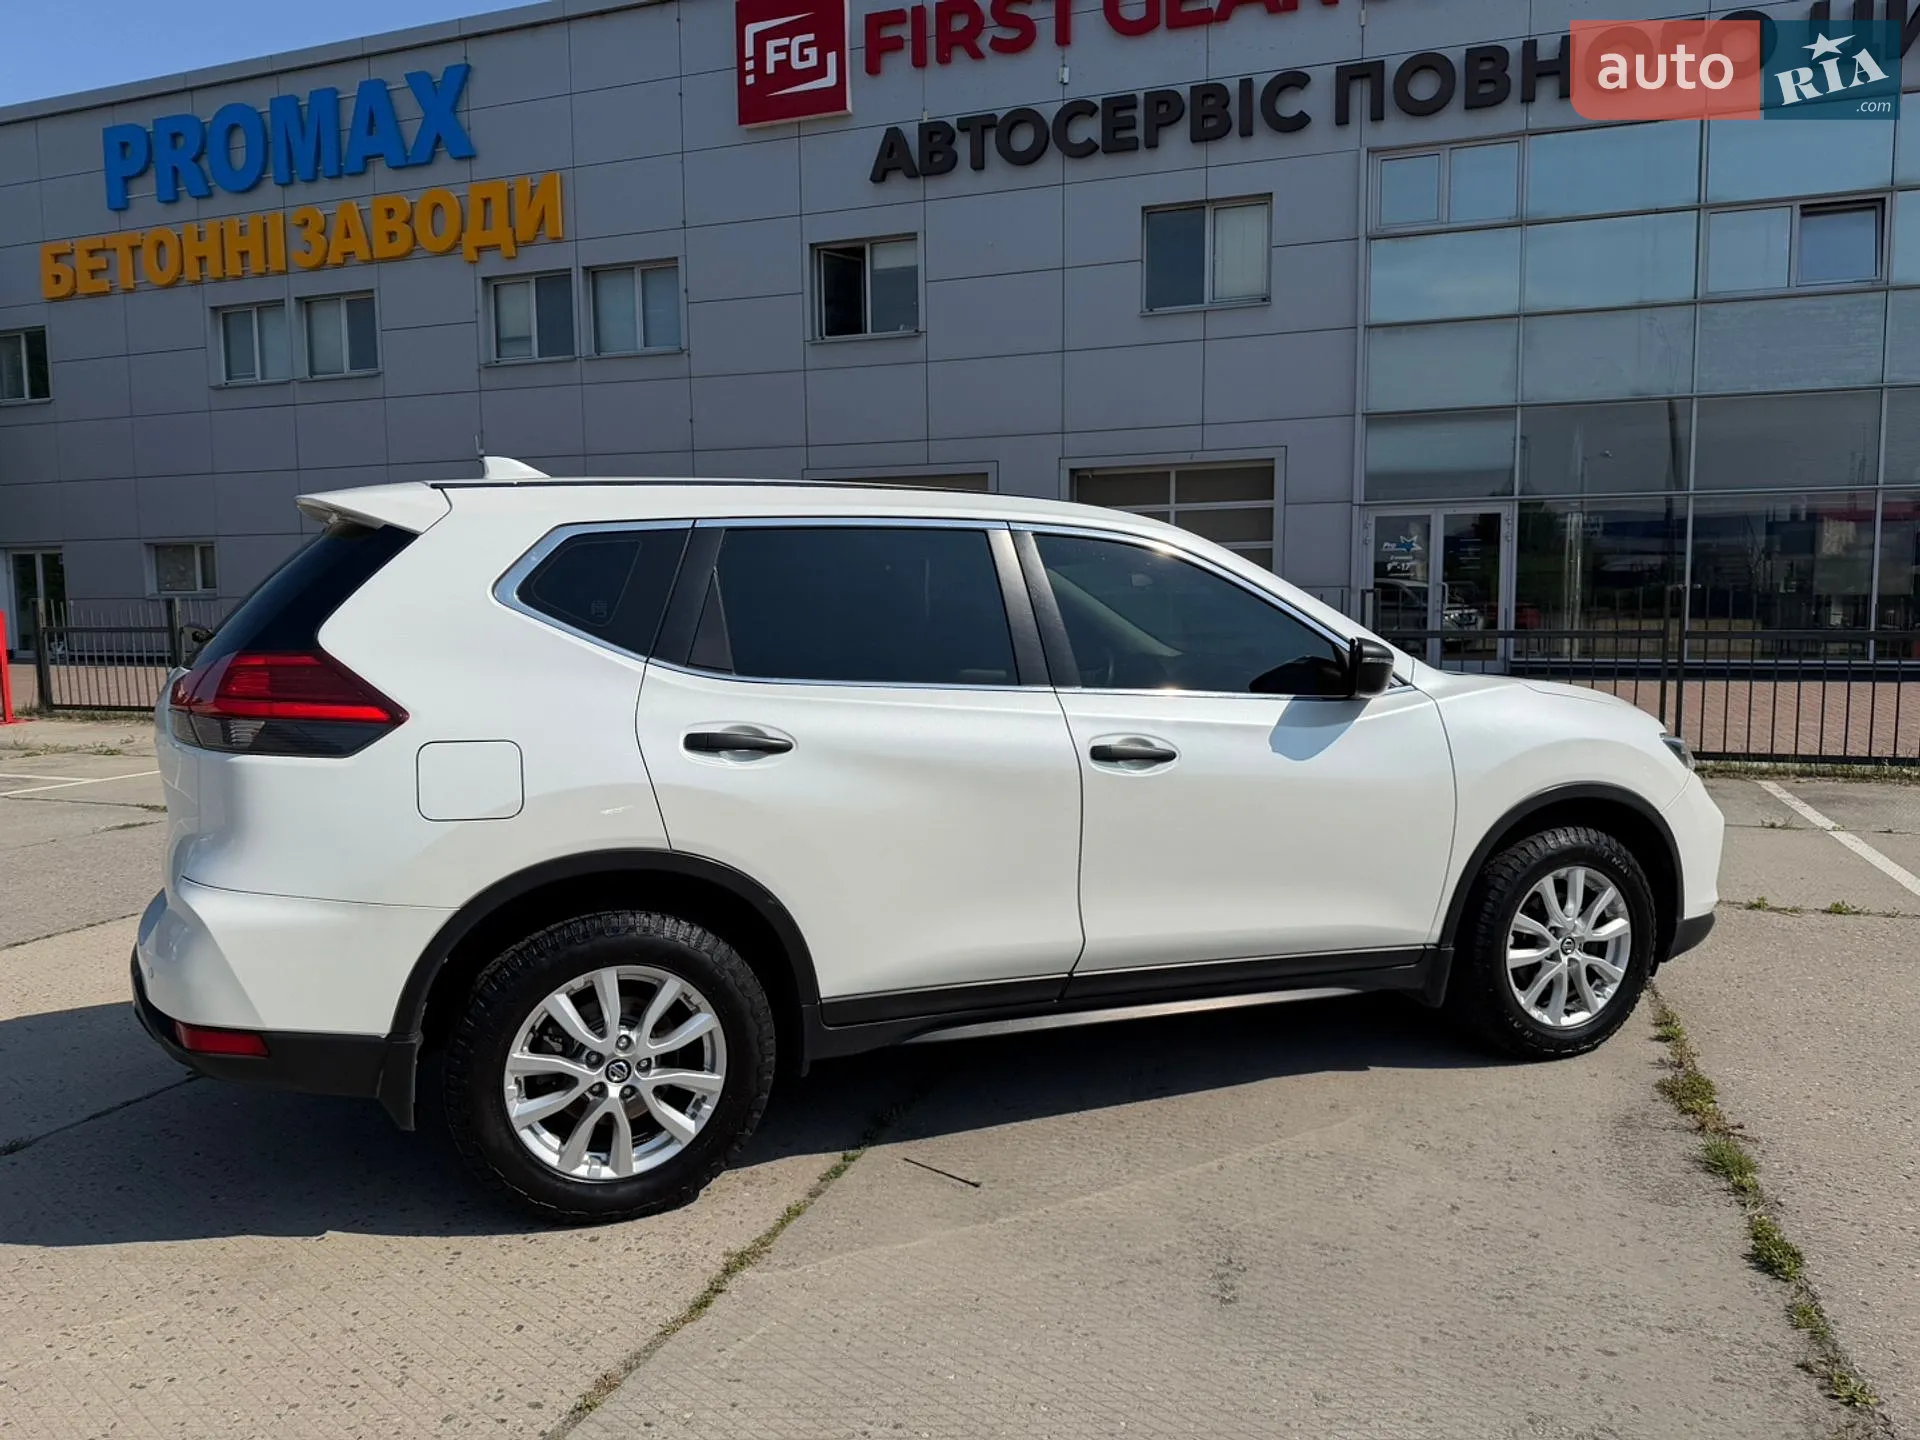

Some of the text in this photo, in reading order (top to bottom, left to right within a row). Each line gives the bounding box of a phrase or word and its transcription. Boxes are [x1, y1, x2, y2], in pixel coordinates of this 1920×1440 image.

[766, 33, 818, 74] FG
[864, 0, 1073, 77] FIRST
[102, 62, 478, 213] PROMAX
[868, 70, 1313, 184] АВТОСЕРВІС
